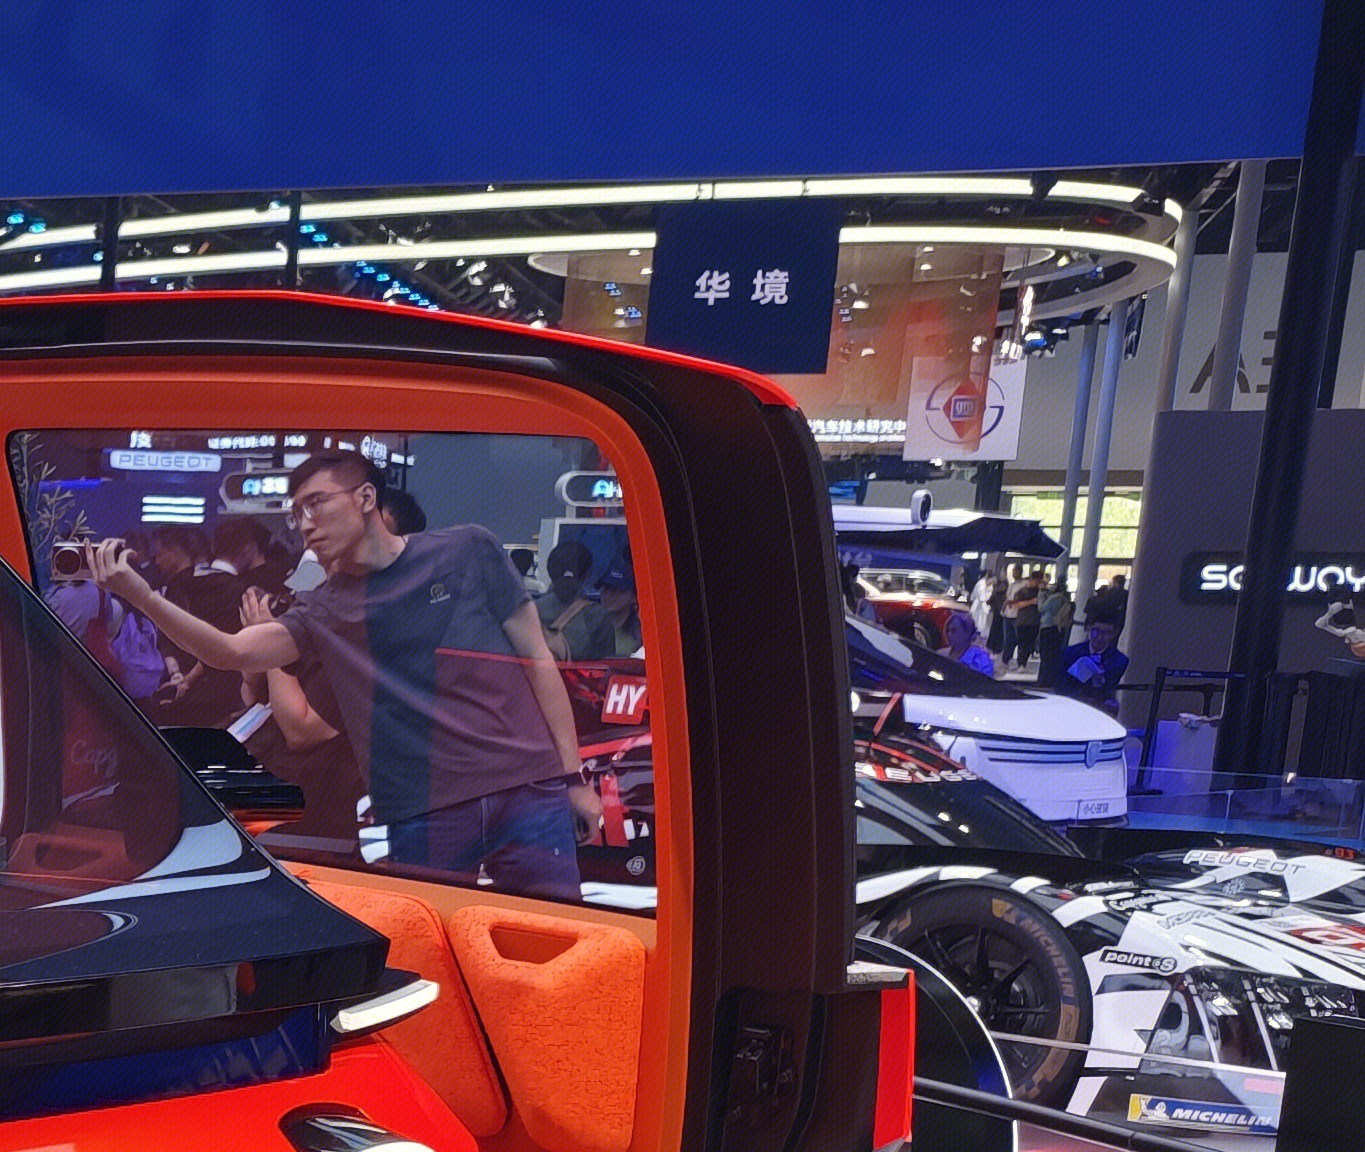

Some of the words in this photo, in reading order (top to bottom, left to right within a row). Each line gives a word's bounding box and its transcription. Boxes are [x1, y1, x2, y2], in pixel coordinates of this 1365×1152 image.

[694, 268, 789, 305] 华境
[119, 453, 213, 469] PEUGEOT
[605, 683, 647, 715] HY
[1186, 849, 1307, 875] PEUGEOT
[1104, 950, 1152, 967] point
[1171, 1107, 1273, 1126] MICHELIN
